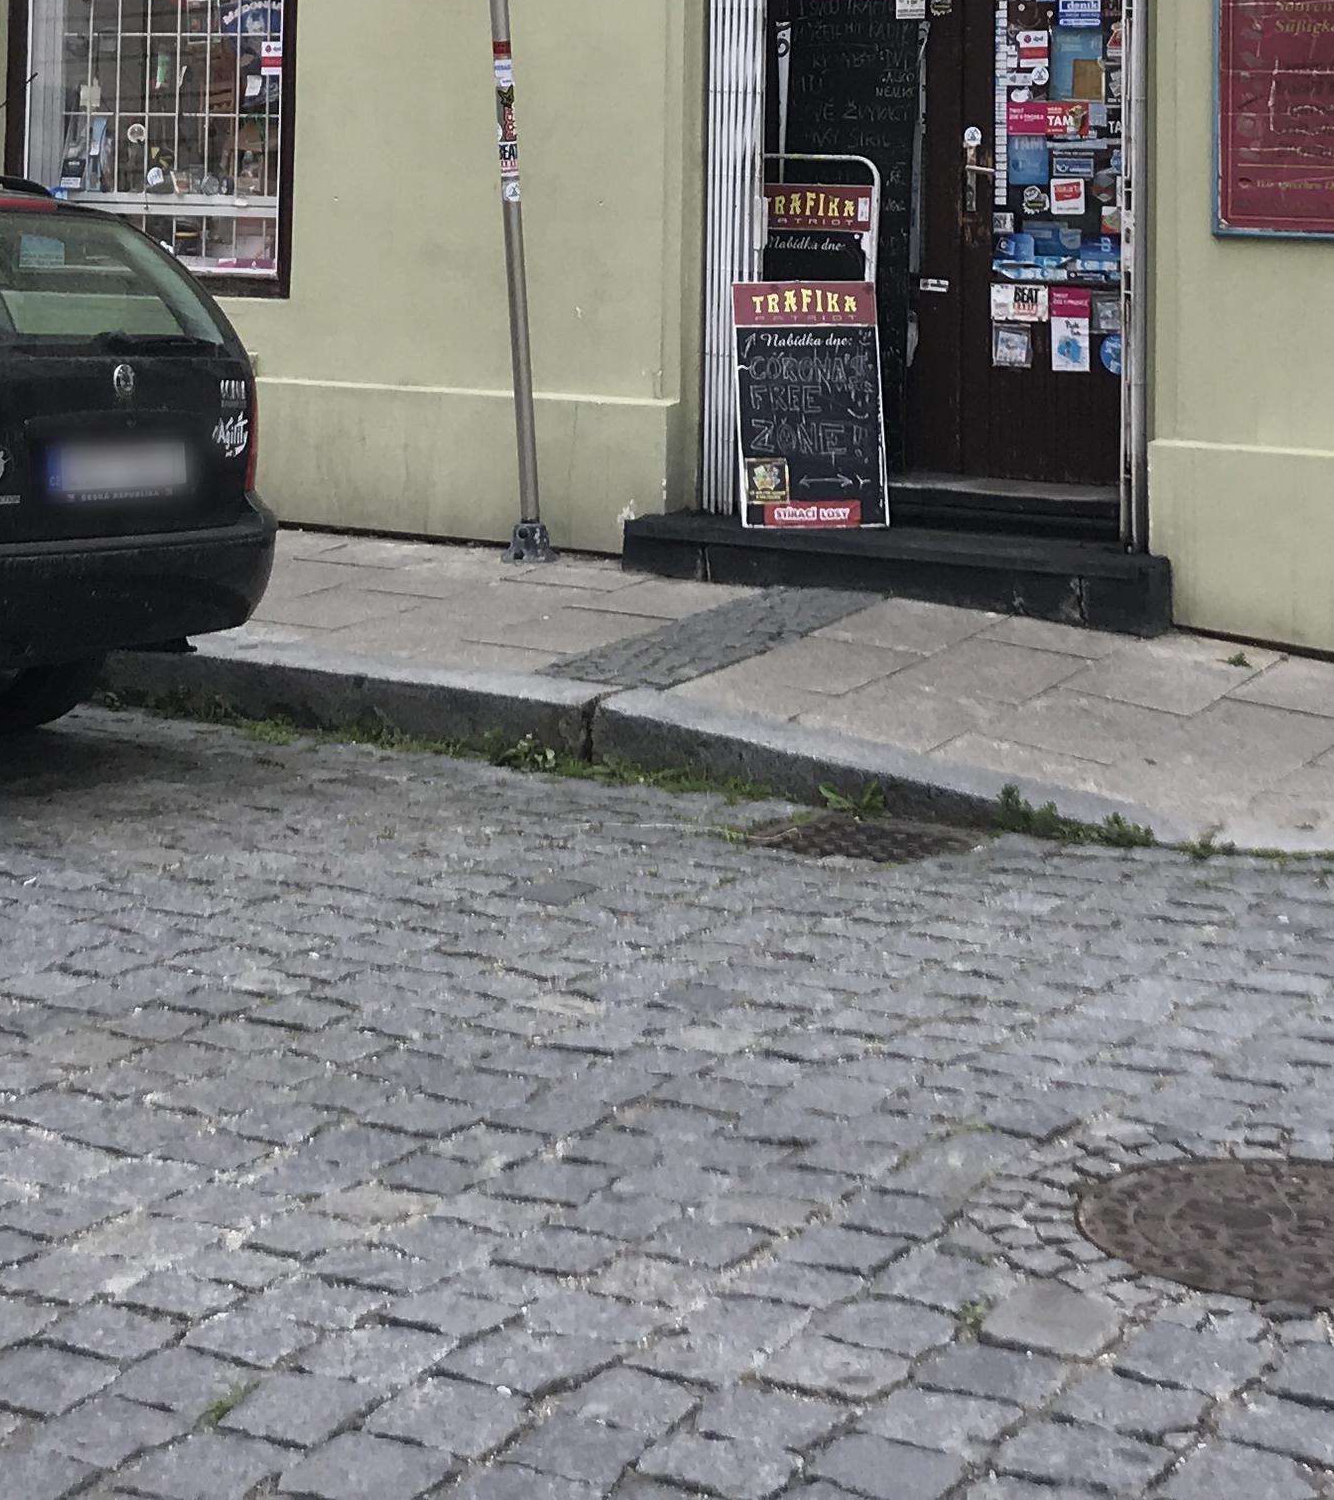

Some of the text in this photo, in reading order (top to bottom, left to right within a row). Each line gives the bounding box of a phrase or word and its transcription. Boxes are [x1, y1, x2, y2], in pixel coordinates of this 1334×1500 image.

[1047, 115, 1074, 126] TAM
[768, 216, 854, 226] ATRIOT
[752, 288, 857, 314] TRAFIKA
[1014, 286, 1040, 303] BEAT
[760, 333, 822, 347] Nabídka
[750, 384, 822, 413] FREE
[819, 507, 850, 520] LOSY
